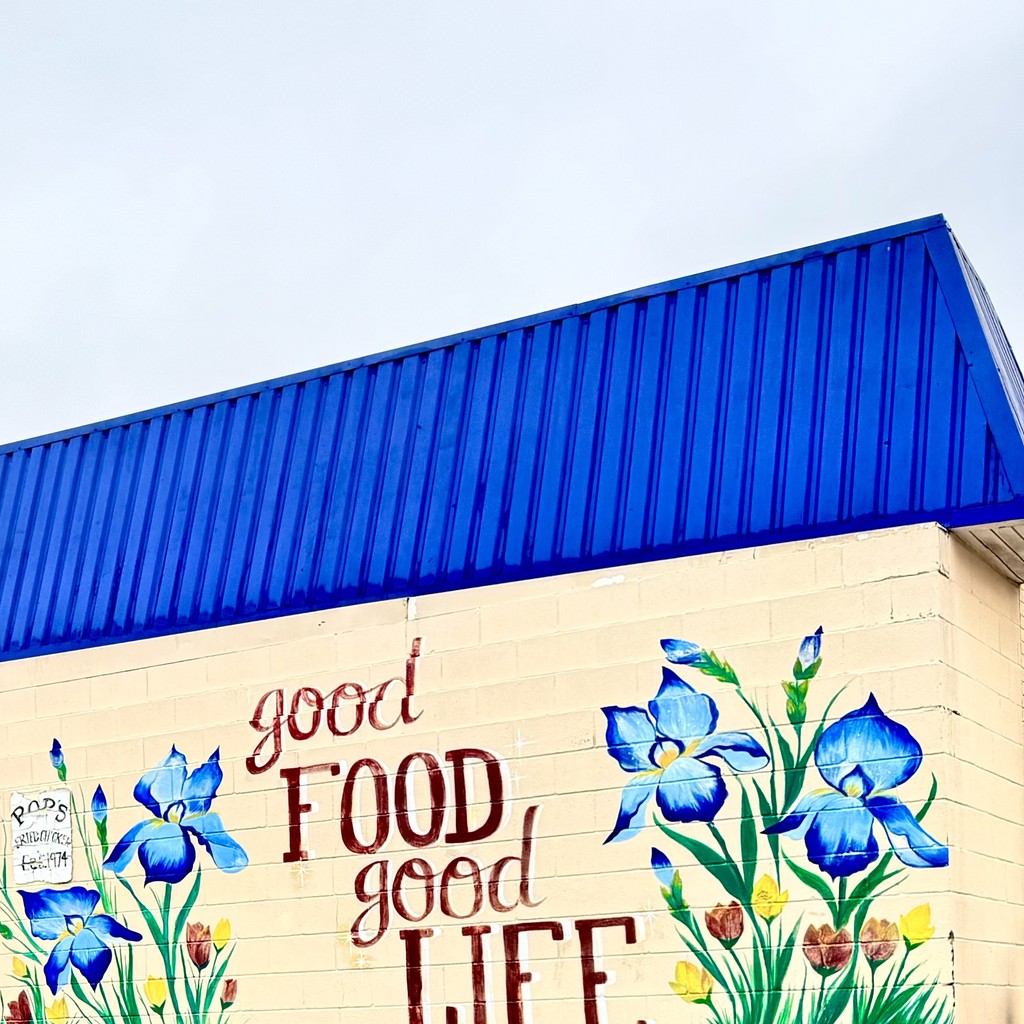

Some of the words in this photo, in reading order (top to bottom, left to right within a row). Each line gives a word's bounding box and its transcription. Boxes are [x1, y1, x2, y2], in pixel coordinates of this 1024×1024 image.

[246, 637, 424, 774] good
[11, 797, 68, 826] POP'S
[47, 851, 68, 868] 1974
[280, 748, 506, 862] FOOD
[351, 804, 549, 948] good
